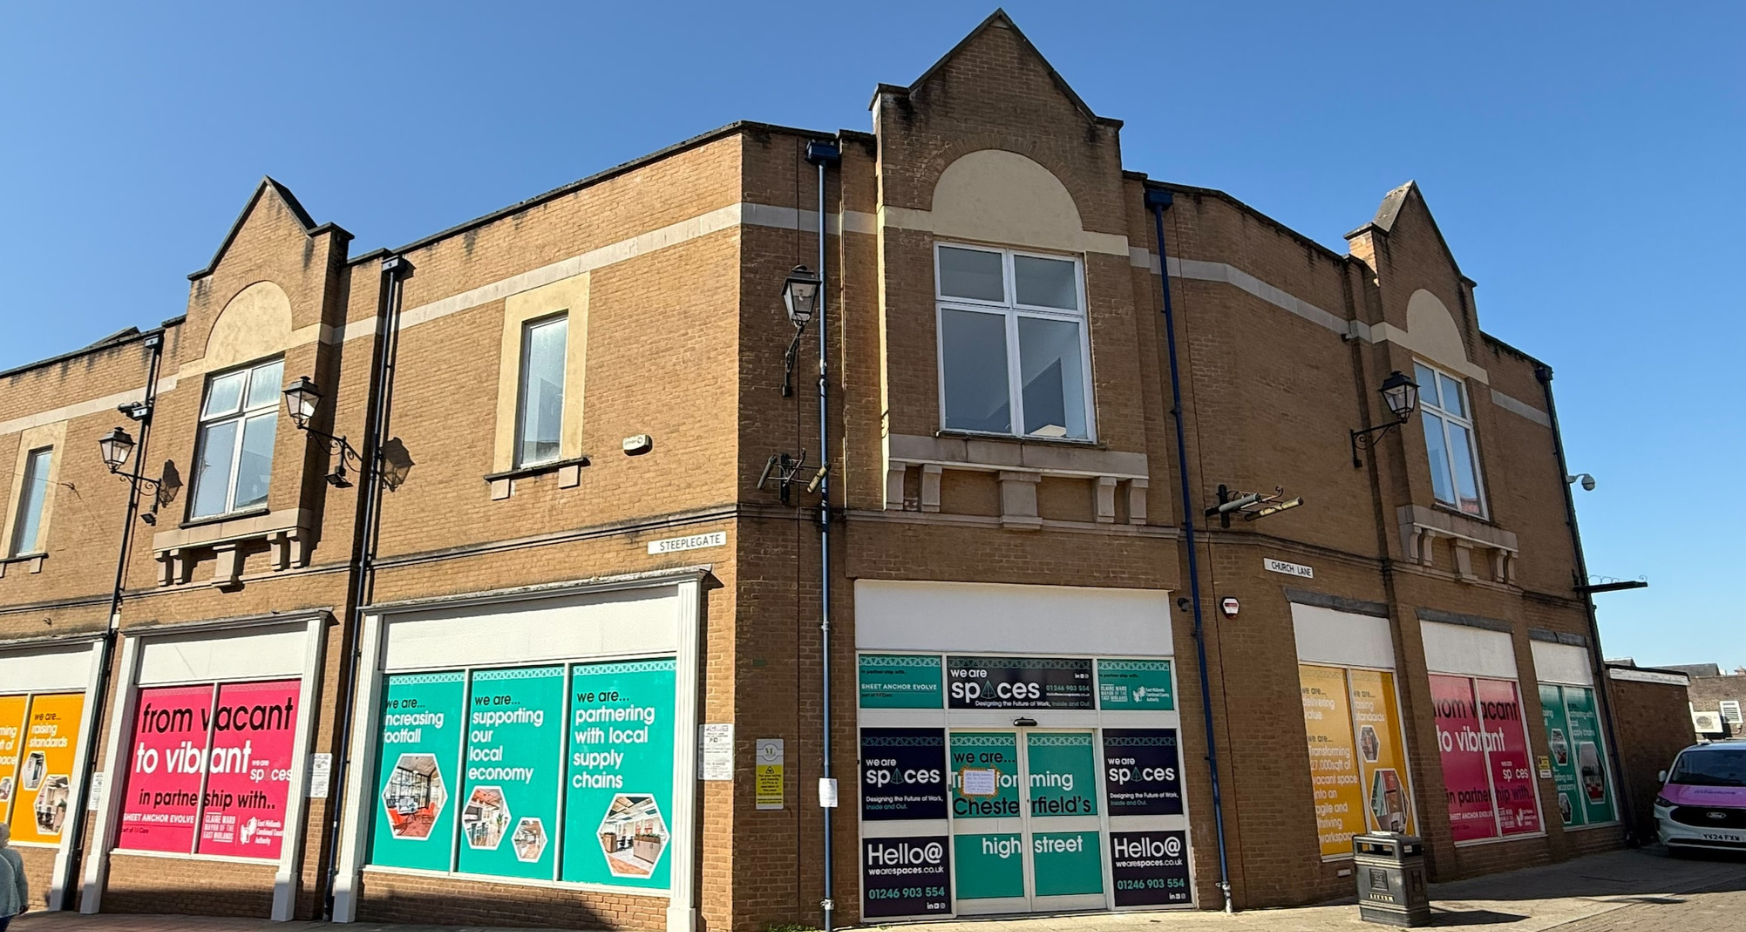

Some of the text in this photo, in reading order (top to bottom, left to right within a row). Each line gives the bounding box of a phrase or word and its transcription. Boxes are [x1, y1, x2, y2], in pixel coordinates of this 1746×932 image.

[659, 534, 721, 551] STEEPLEGATE
[1271, 561, 1312, 576] CHURCH LANE
[950, 669, 988, 678] we are
[474, 694, 521, 706] we are...
[577, 690, 630, 703] we are...
[386, 699, 399, 709] we
[141, 697, 293, 733] from vacant
[472, 708, 544, 727] supporting
[575, 704, 655, 726] partnering
[31, 723, 58, 737] raising
[471, 729, 494, 743] our
[575, 725, 649, 744] with local
[28, 736, 68, 748] standards
[1436, 724, 1453, 752] to
[135, 742, 159, 774] to
[469, 745, 503, 762] local
[573, 749, 624, 769] supply
[953, 752, 1016, 763] we are...
[1308, 745, 1351, 759] Transforming
[866, 759, 897, 767] we are
[468, 766, 534, 784] economy
[572, 771, 624, 789] chains
[951, 771, 1074, 791] Trforming
[1312, 774, 1358, 785] vacant space
[1502, 769, 1529, 783] spces
[139, 789, 150, 805] in
[153, 789, 233, 811] partneship
[1328, 790, 1337, 798] an
[1458, 787, 1510, 807] partnerhip
[953, 796, 1091, 815] Chesterfield's
[1315, 802, 1348, 816] agile and
[123, 812, 194, 823] SHEET ANCHOR EVOLVE
[868, 842, 943, 866] Hello@
[982, 835, 1083, 859] high street
[1114, 836, 1181, 859] Hello@
[1116, 858, 1183, 868] wearespaces.co.uk
[868, 866, 944, 876] wearespaces.co.uk
[1117, 878, 1185, 890] 01246 903 554
[868, 886, 945, 900] 01246 903 554
